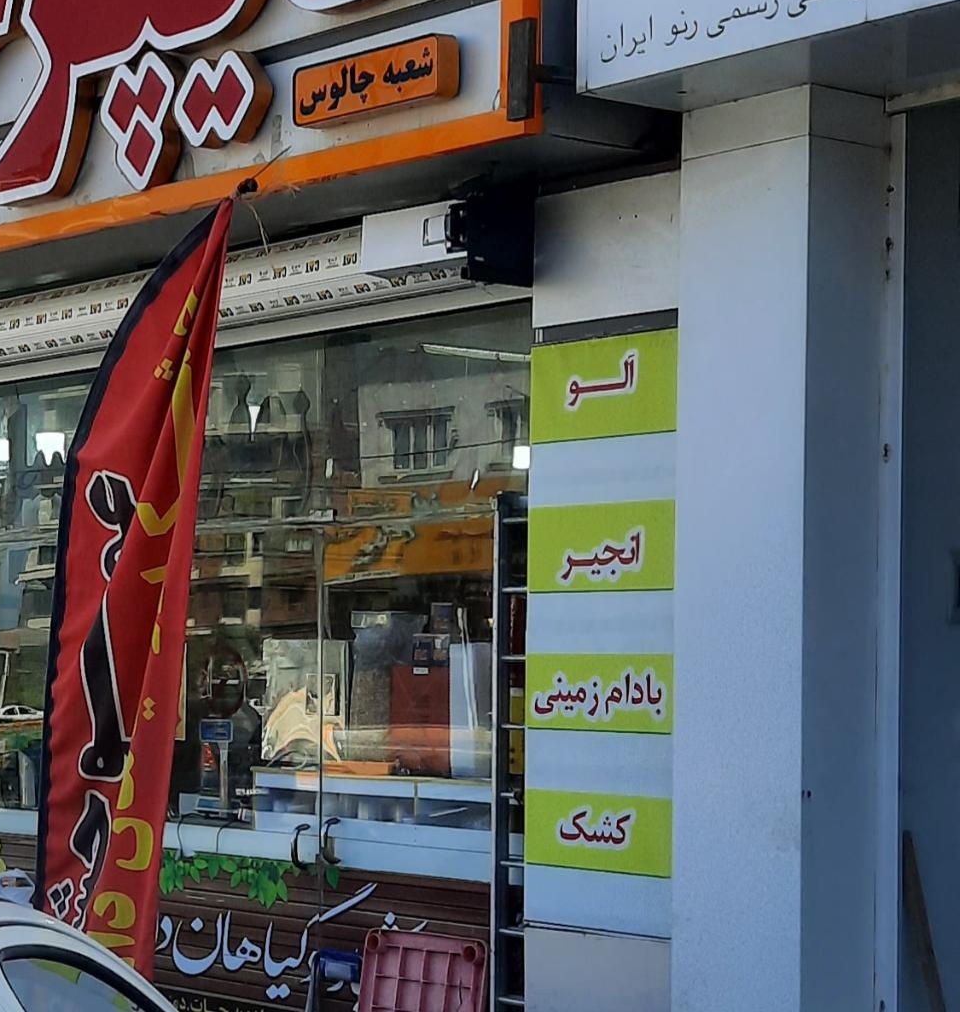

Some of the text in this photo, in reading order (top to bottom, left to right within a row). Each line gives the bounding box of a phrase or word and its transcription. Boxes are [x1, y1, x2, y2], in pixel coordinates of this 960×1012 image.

[600, 15, 653, 63] ایران
[664, 10, 699, 46] رنو
[300, 47, 434, 115] شعبه چالوس
[561, 531, 641, 581] انجیر
[534, 672, 662, 717] بادام زمینی
[560, 810, 632, 845] کشک
[172, 882, 378, 1000] گیاهان
